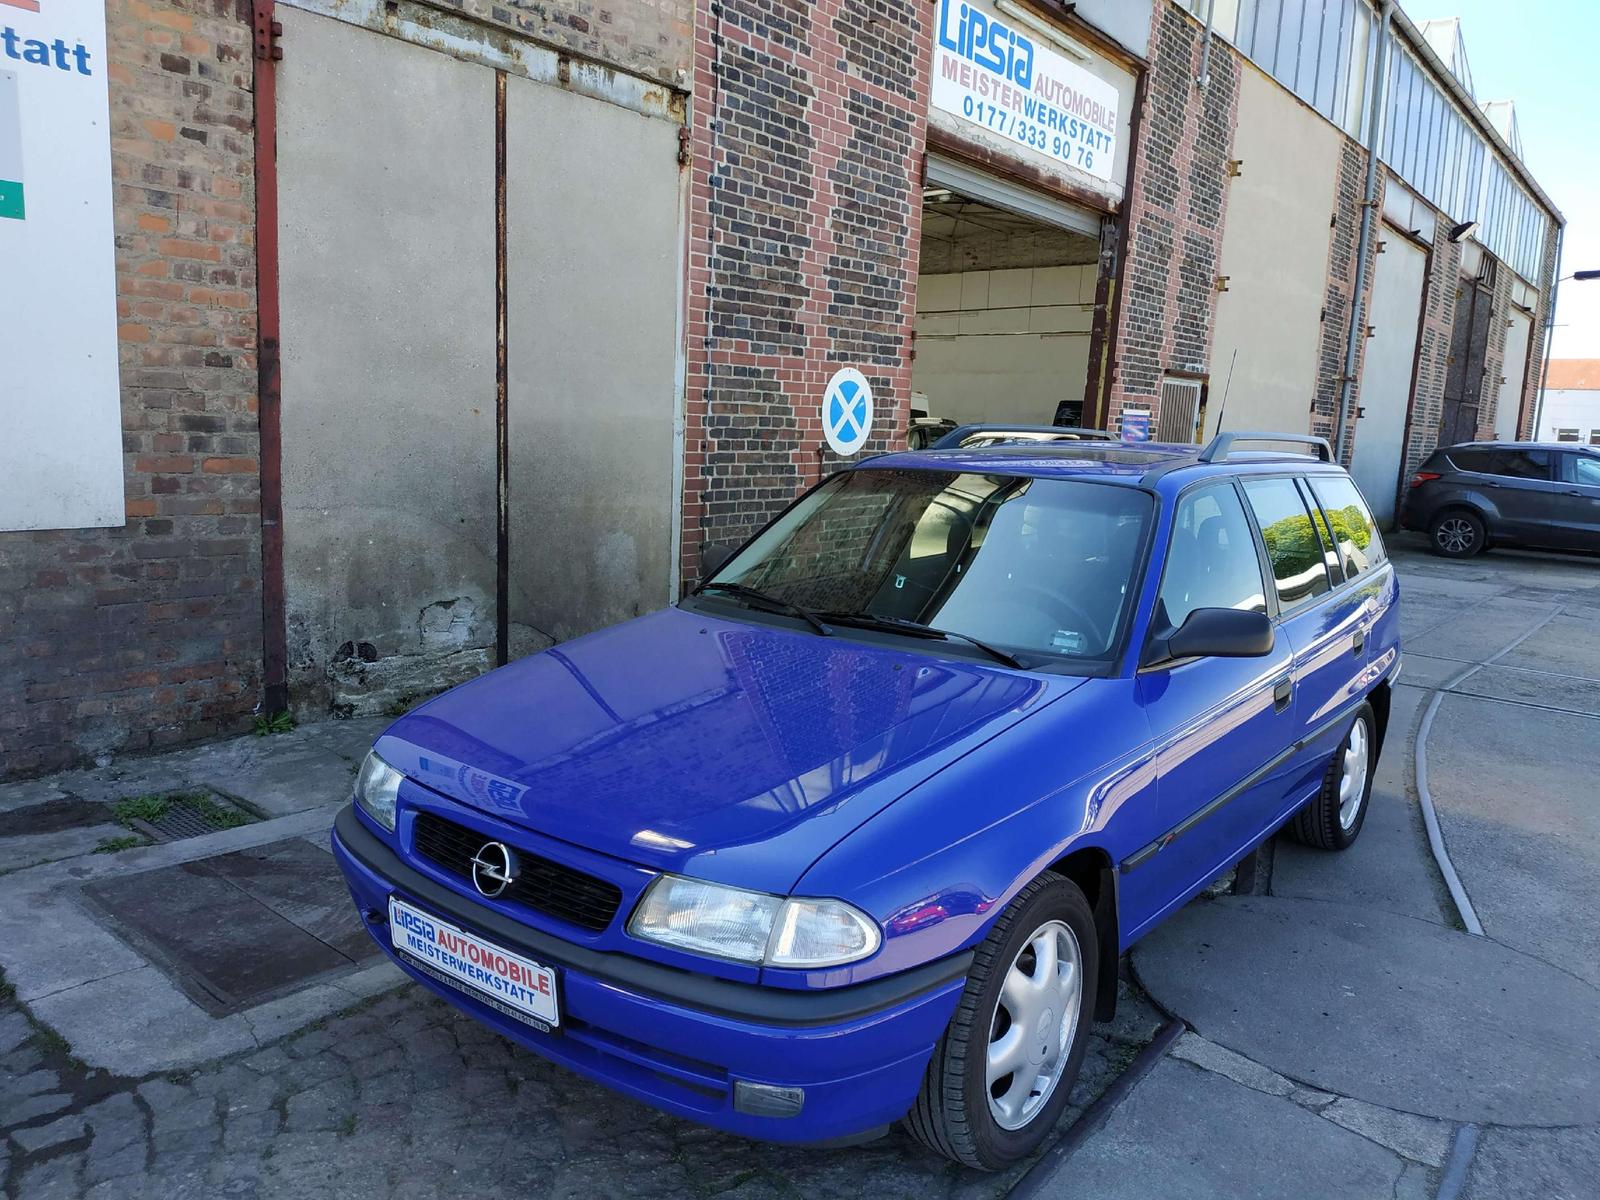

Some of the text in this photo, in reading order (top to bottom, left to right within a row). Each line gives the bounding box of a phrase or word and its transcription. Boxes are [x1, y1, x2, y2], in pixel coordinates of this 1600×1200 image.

[0, 27, 92, 76] tatt
[941, 54, 1111, 154] MEISTERWERKSTATT
[1034, 73, 1116, 133] AUTOMOBILE
[1053, 136, 1071, 160] 90
[1077, 146, 1093, 169] 76
[407, 934, 535, 1005] MEISTERWERKSTATT
[437, 929, 551, 996] AUTOMOBILE
